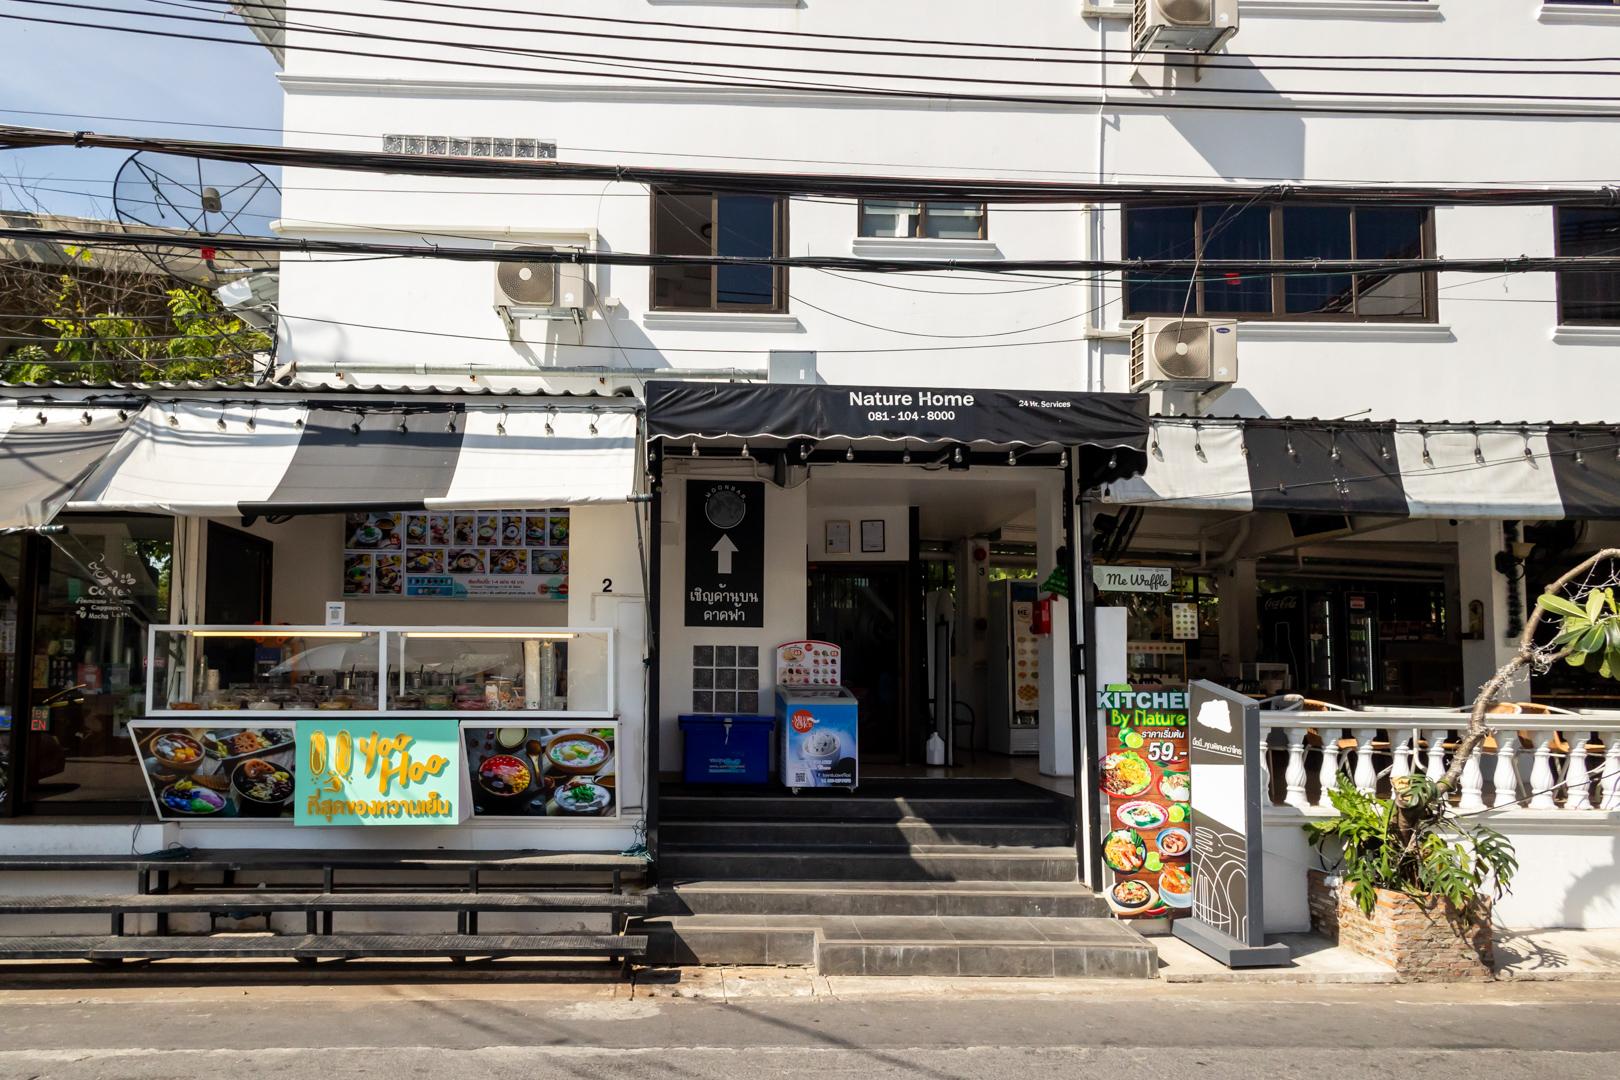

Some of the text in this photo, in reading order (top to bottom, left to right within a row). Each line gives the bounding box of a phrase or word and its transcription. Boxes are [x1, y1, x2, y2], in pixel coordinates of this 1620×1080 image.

[849, 391, 975, 407] Nature Home
[1018, 399, 1029, 407] 24
[1040, 400, 1071, 408] Services
[867, 411, 890, 421] 081
[897, 411, 919, 421] 104
[927, 411, 955, 421] 8000
[978, 568, 985, 576] 3
[602, 578, 613, 593] 2
[1106, 573, 1169, 590] Me Waffle
[690, 583, 759, 605] เชิญด้านบน
[703, 602, 746, 622] ดาดฟ้า
[1096, 691, 1189, 709] KITCHE
[1111, 709, 1187, 728] By Nature
[1141, 727, 1185, 739] ราคาเริ่มต้น
[359, 730, 413, 775] Yoo
[1147, 741, 1188, 762] 59.-
[379, 750, 450, 794] Hoo
[306, 788, 453, 823] ที่สุดของหวานเย็น
